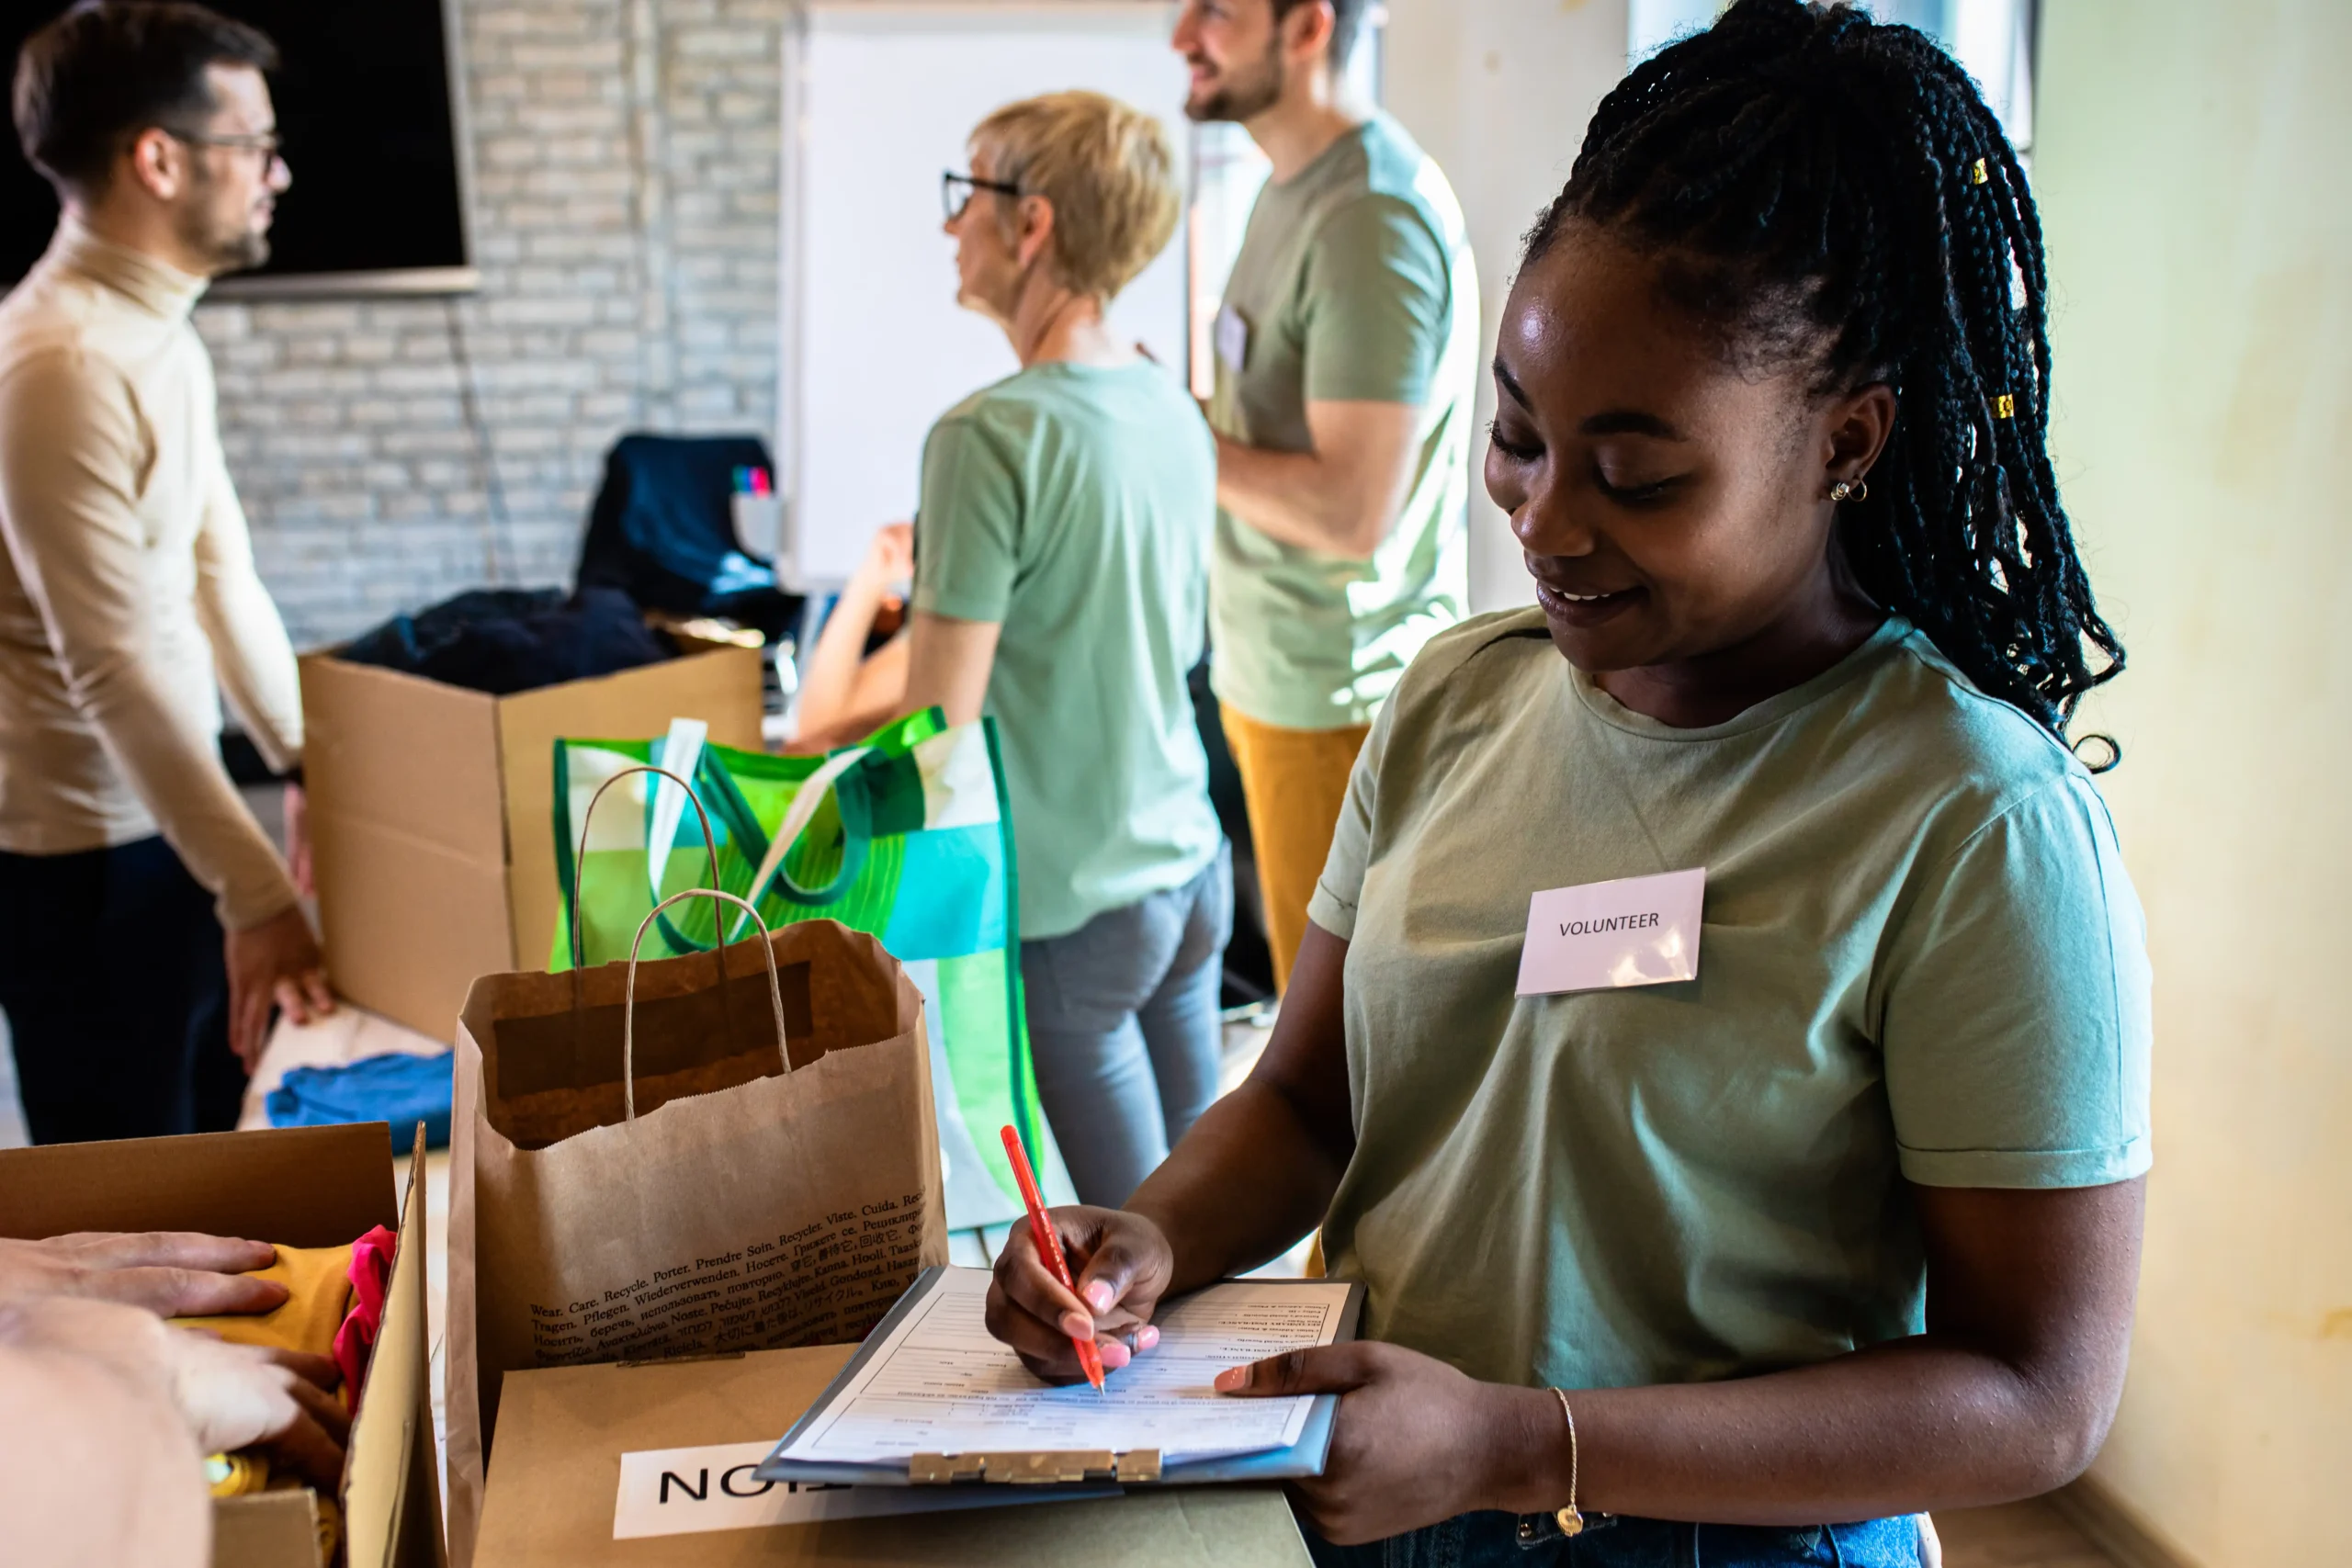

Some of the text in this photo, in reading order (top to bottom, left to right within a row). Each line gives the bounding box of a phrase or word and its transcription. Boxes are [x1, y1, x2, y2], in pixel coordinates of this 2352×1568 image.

[1560, 913, 1658, 936] VOLUNTEER
[530, 1304, 563, 1317] Wear.
[570, 1300, 599, 1313] Care.
[605, 1280, 649, 1302] Recycle.
[653, 1265, 691, 1282] Porter.
[695, 1252, 741, 1269] Prendre
[747, 1243, 775, 1257] Soin.
[779, 1224, 822, 1246] Recycler.
[826, 1212, 856, 1224] Viste.
[862, 1201, 898, 1215] Cuida.
[531, 1319, 577, 1334] Tragen.
[583, 1304, 629, 1325] Pflegen.
[635, 1269, 740, 1305] Wiederverwenden.
[746, 1254, 788, 1273] Носете.
[794, 1233, 836, 1256] Грижете
[842, 1227, 857, 1236] се.
[672, 1309, 707, 1325] Noste.
[711, 1297, 754, 1314] Pečujte.
[815, 1260, 849, 1278] Kanna.
[852, 1248, 886, 1265] Hooli.
[831, 1265, 884, 1286] Gondozd.
[534, 1334, 583, 1348] Носить,
[591, 1319, 634, 1338] беречь,
[641, 1290, 720, 1321] использовать
